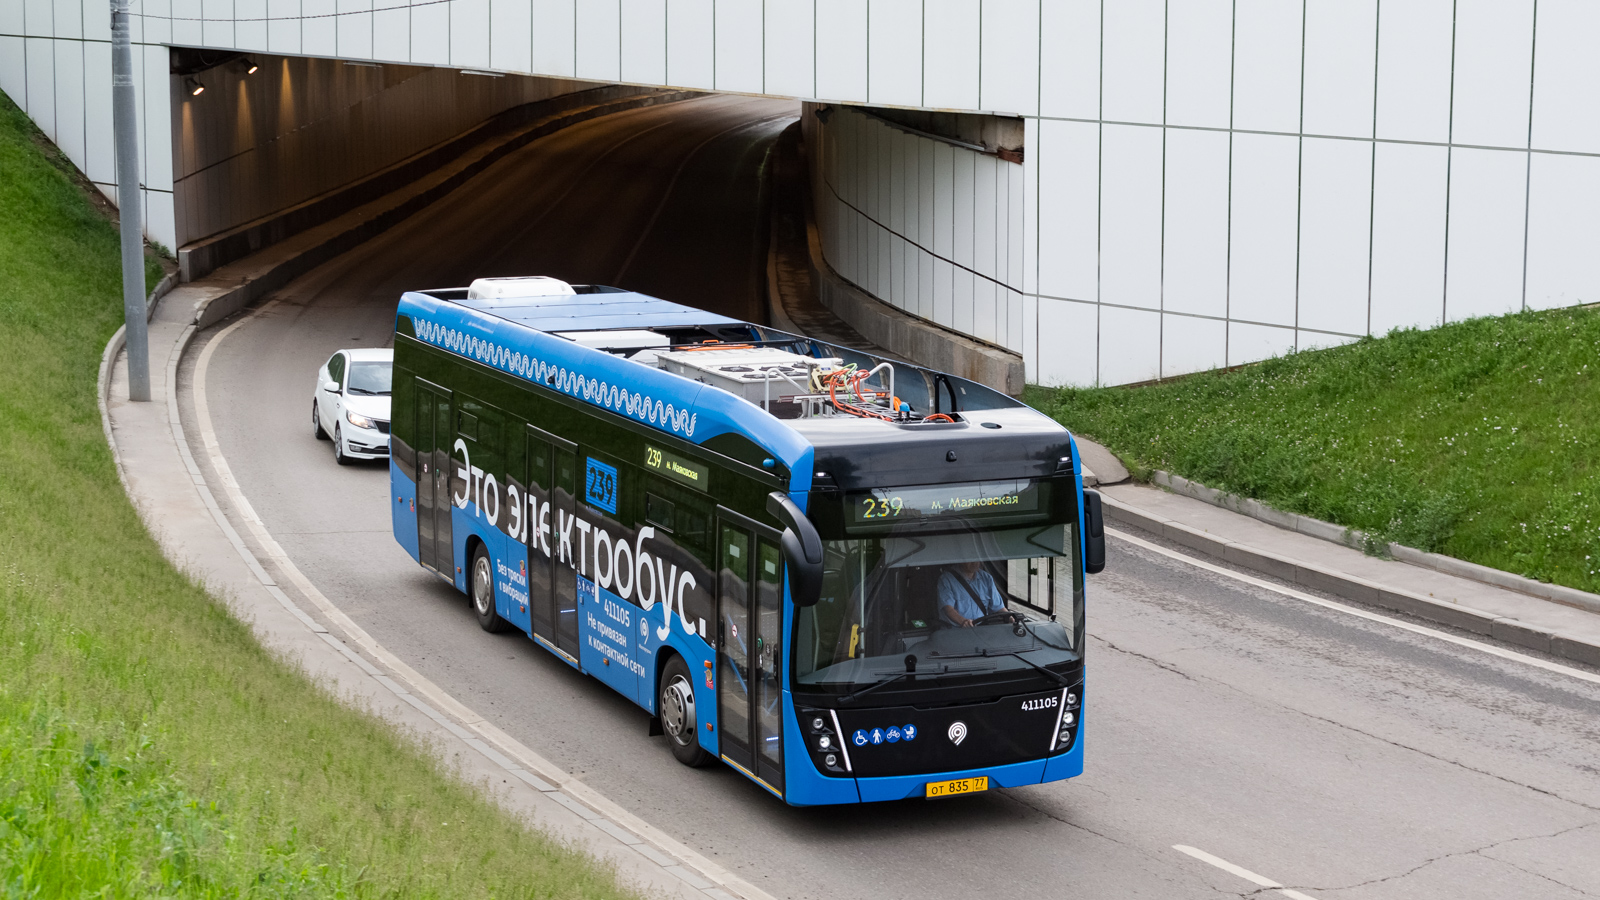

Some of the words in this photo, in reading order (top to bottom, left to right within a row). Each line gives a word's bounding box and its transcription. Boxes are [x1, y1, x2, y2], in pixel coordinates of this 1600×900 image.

[646, 446, 662, 469] 239
[589, 466, 614, 506] 239
[862, 496, 904, 519] 239
[931, 500, 944, 510] м.
[948, 495, 1019, 509] Маяковская
[454, 438, 499, 527] Это
[507, 484, 707, 642] электробус.
[496, 558, 507, 577] Без
[507, 567, 526, 588] тряски
[502, 582, 529, 606] вибраций
[603, 598, 631, 628] 411105
[587, 611, 597, 630] Не
[597, 620, 627, 648] привязан
[588, 634, 593, 647] к
[592, 637, 629, 669] контактной
[629, 659, 646, 679] сети
[1021, 696, 1058, 711] 411105
[948, 780, 969, 793] 835
[974, 777, 985, 787] 77
